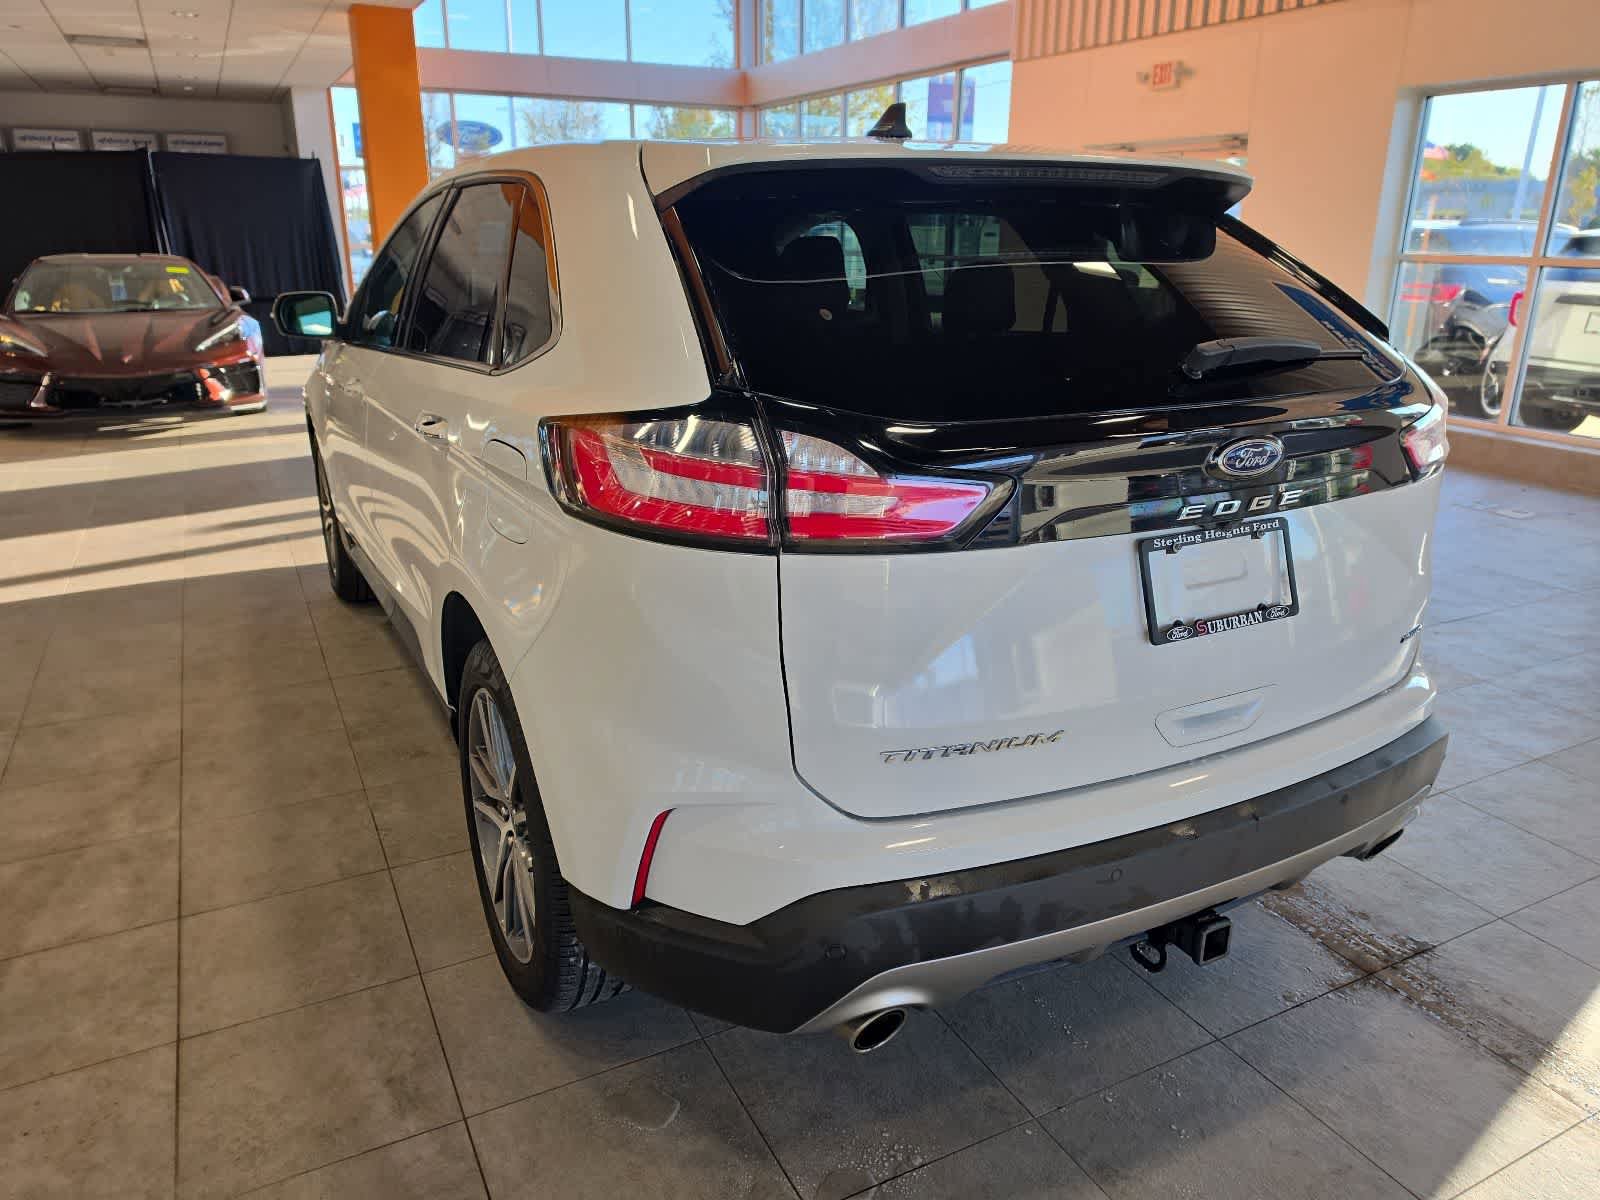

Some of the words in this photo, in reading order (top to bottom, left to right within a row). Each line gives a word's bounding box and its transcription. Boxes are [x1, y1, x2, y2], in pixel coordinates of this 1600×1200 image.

[1235, 447, 1271, 468] Ford
[1176, 489, 1304, 521] EDGE
[1153, 533, 1202, 549] Sterling
[1252, 519, 1280, 533] Ford
[1195, 610, 1264, 636] SUBURBAN
[879, 729, 1065, 764] TITANIUM
